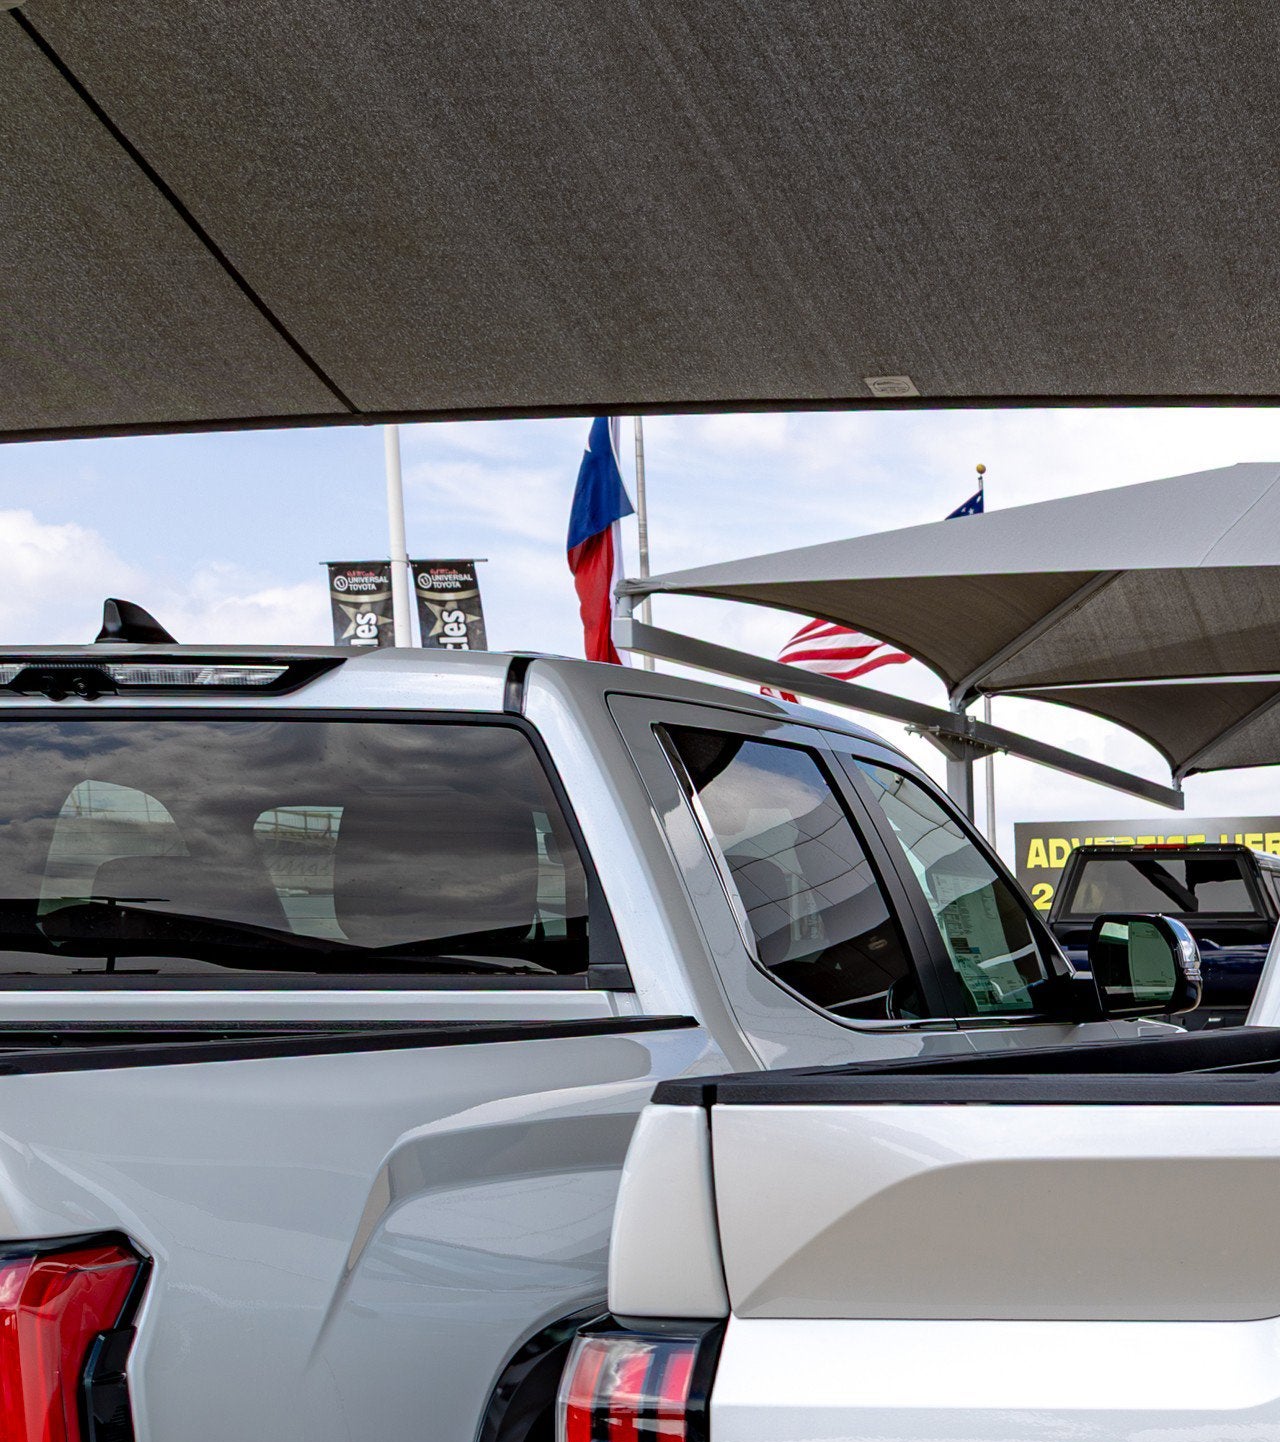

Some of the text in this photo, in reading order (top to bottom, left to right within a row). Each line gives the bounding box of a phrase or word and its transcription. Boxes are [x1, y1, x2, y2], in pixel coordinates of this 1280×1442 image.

[347, 576, 389, 584] UNIVERSAL
[431, 573, 473, 581] UNIVERSAL
[349, 583, 377, 591] TOYOTA
[432, 581, 462, 589] TOYOTA
[350, 612, 379, 647] les
